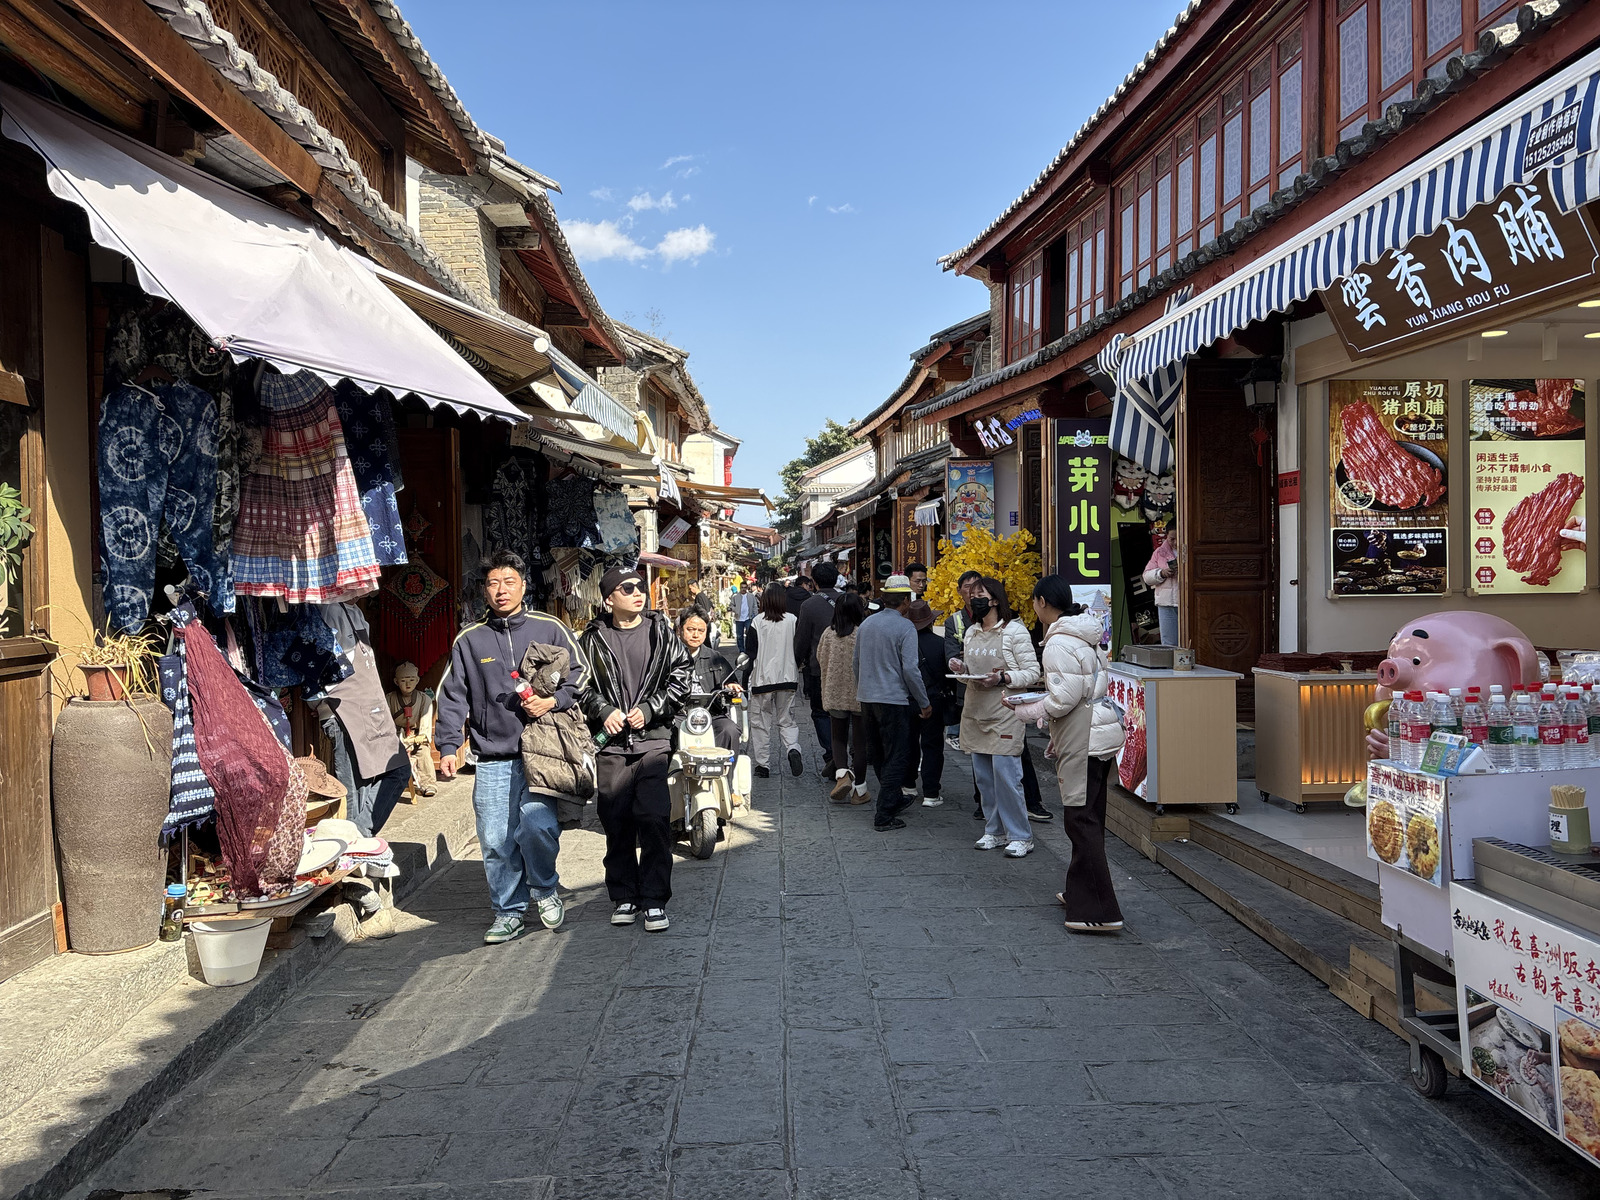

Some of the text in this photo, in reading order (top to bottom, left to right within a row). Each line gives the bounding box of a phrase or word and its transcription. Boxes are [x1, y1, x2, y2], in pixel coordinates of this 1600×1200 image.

[1405, 284, 1511, 329] YUN XIANG ROU FU
[1402, 381, 1445, 399] 原切
[1381, 398, 1445, 415] 猪肉脯
[1508, 401, 1539, 411] 更带劲
[1476, 453, 1519, 462] 闲适生活
[1476, 463, 1552, 473] 少不了精制小食
[1068, 456, 1100, 578] 芽小七
